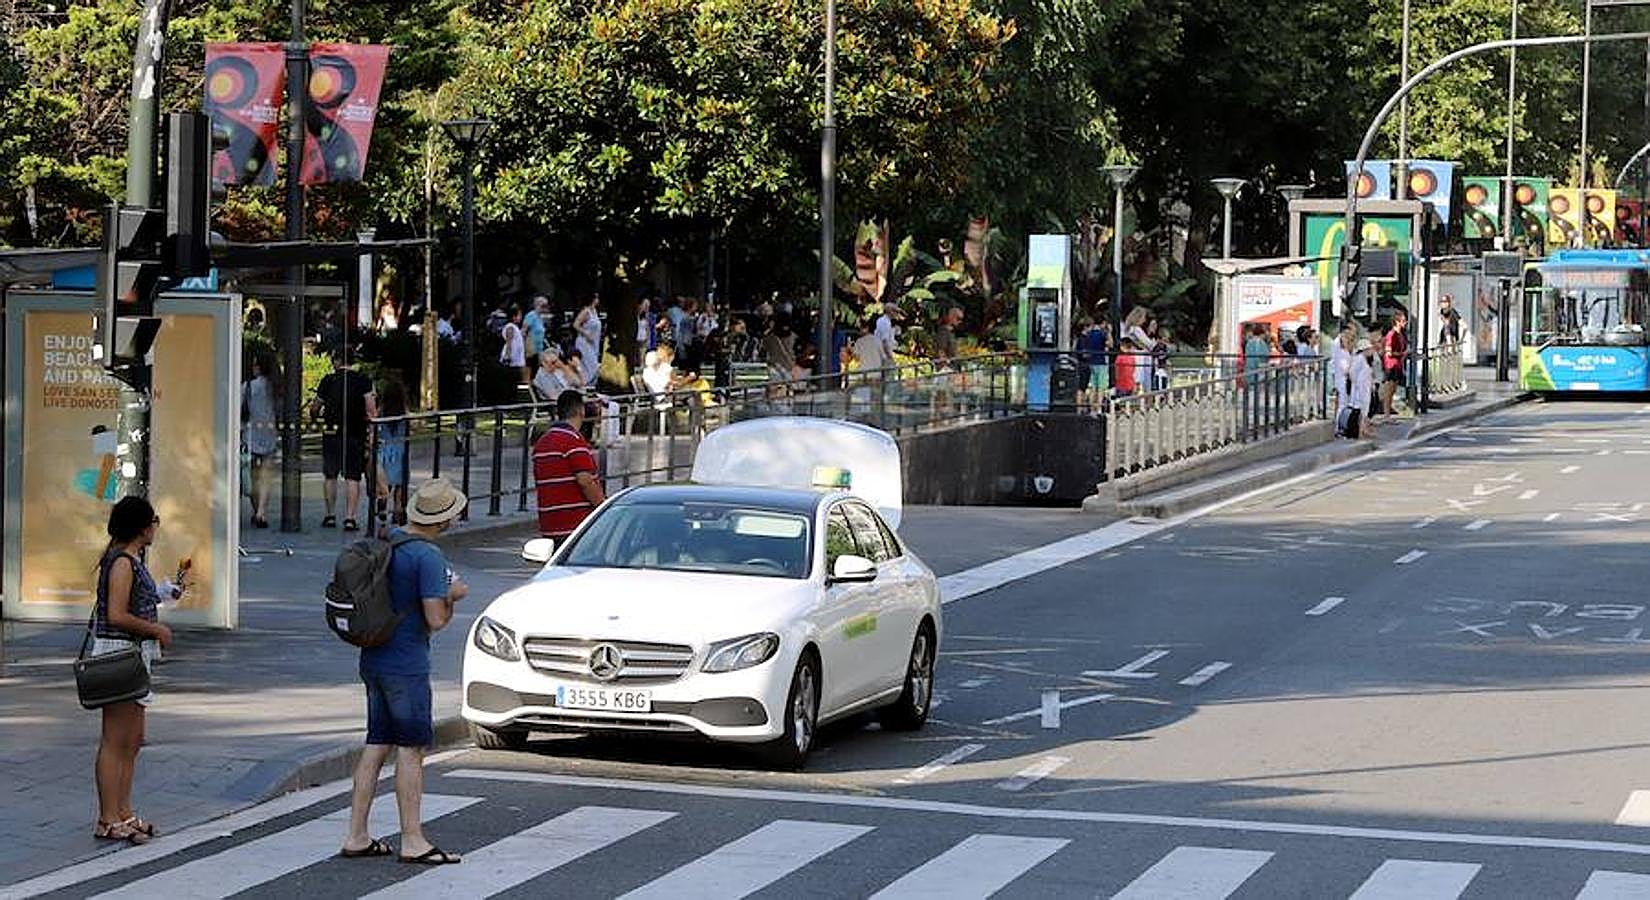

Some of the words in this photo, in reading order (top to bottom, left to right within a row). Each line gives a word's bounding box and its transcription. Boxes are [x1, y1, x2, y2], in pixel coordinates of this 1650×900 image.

[44, 335, 95, 350] ENJOY
[44, 369, 78, 384] AND
[82, 370, 120, 385] PAR
[71, 399, 118, 409] DONOSTI
[568, 688, 607, 706] 3555
[614, 692, 646, 708] KBG
